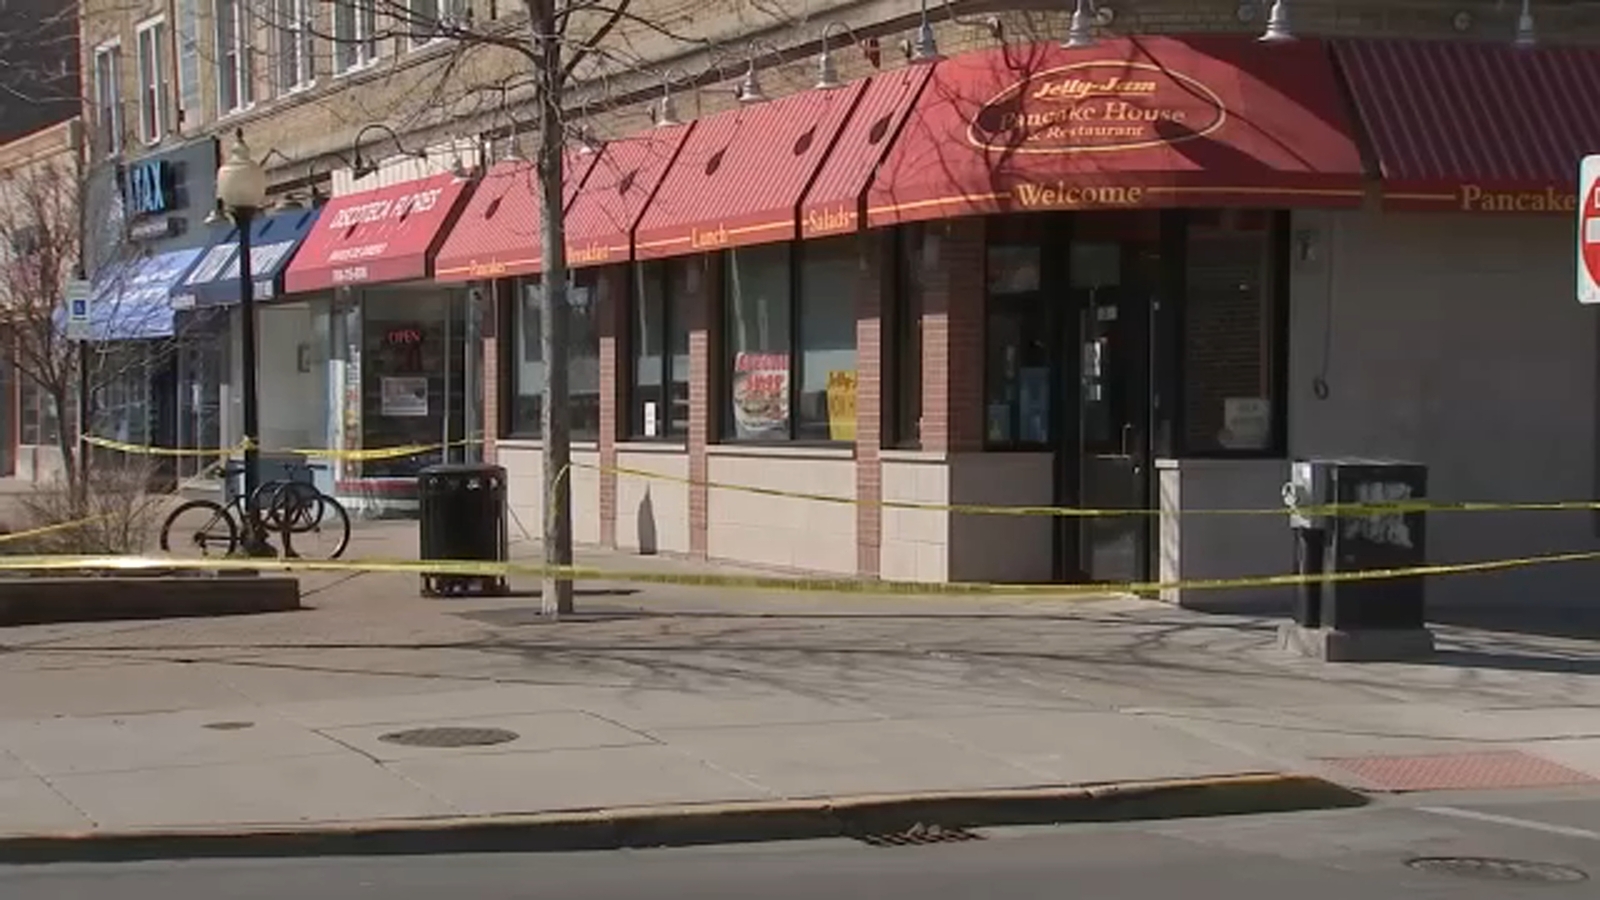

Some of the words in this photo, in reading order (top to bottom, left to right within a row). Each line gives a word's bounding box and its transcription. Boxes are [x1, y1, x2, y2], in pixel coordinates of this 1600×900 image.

[1033, 76, 1156, 99] Jelly-Jam
[1000, 104, 1097, 131] Pancake
[1102, 101, 1187, 124] House
[1046, 124, 1144, 140] Restaurant
[1016, 179, 1143, 207] Welcome
[809, 203, 850, 232] Salads
[691, 221, 729, 248] Lunch
[388, 329, 421, 345] OPEN
